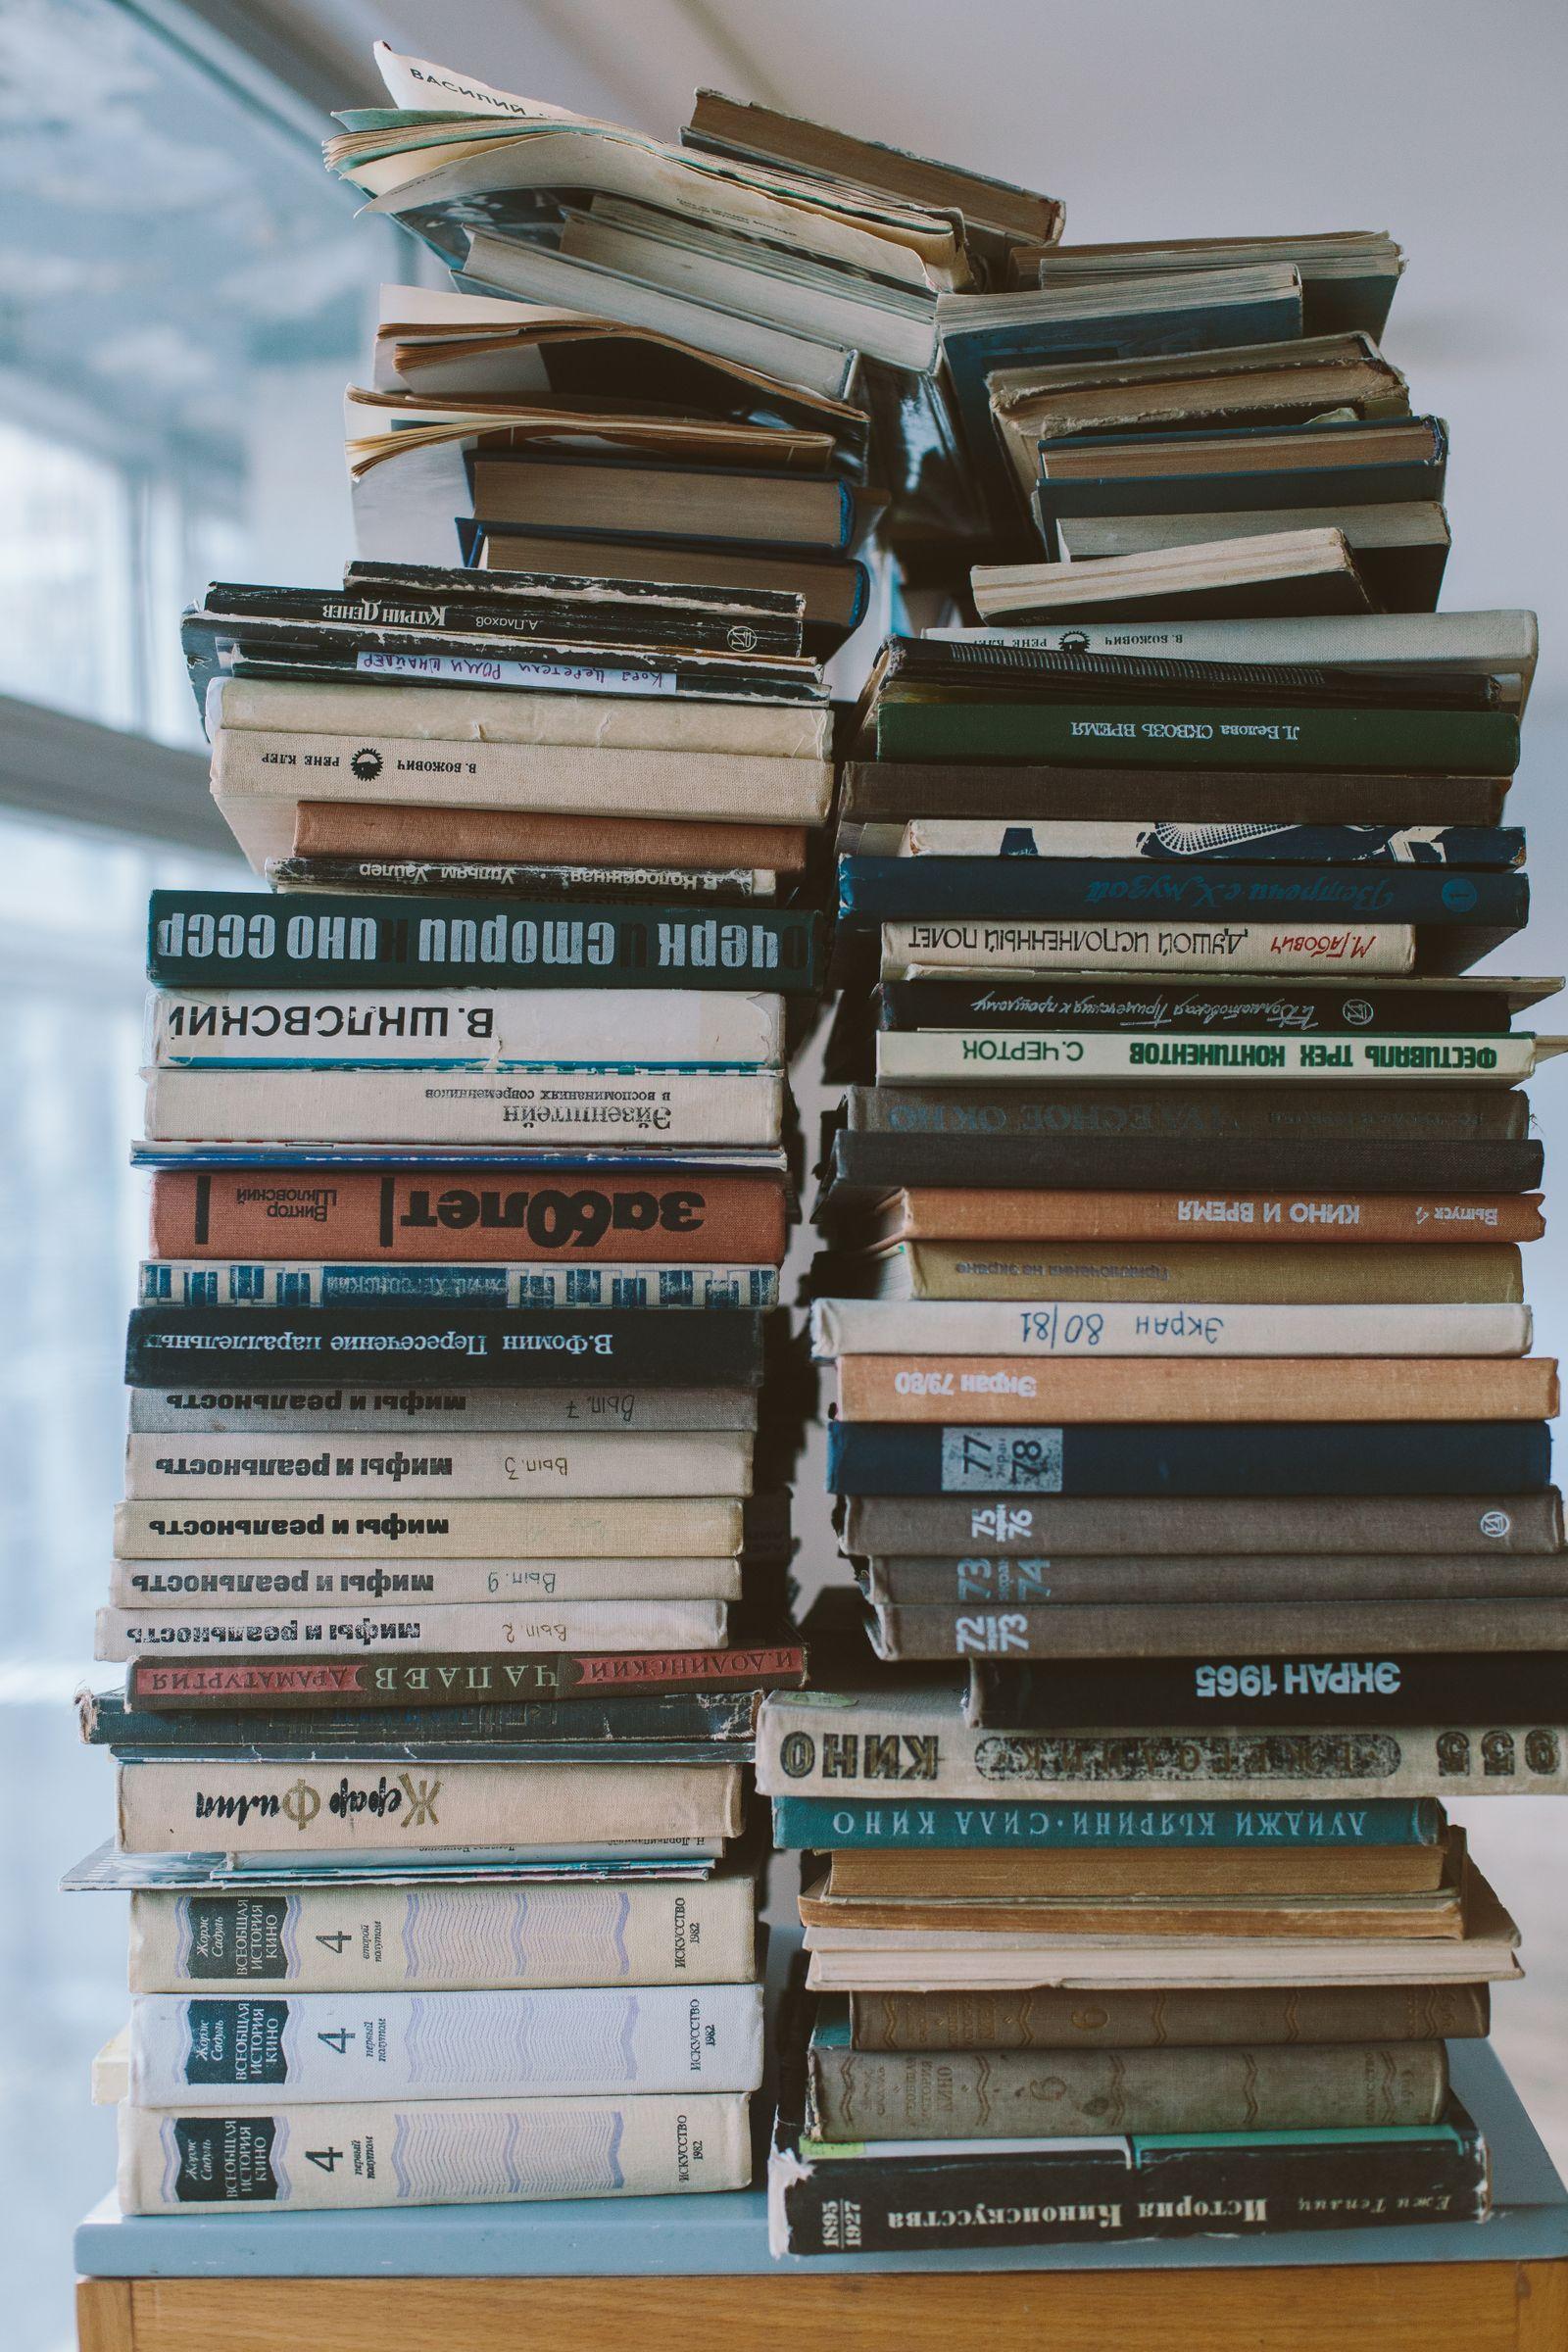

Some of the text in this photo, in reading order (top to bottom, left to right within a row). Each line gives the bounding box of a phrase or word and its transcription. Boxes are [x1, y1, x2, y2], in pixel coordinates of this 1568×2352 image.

[409, 68, 526, 116] ВАСИЛИЙ
[320, 598, 381, 626] ДЕНЕВ
[381, 605, 446, 628] КАТРИН
[1011, 633, 1184, 649] В. БОЖОВИЧ РЕНЕ
[517, 662, 605, 685] Церетели
[621, 669, 662, 689] Кора
[1070, 720, 1299, 741] Л. Белова СКВОЗЬ ВРЕМЯ
[260, 752, 476, 774] В. БОЖОВИЧ РЕНЕ КЛЕР
[1085, 874, 1189, 910] музой
[1245, 875, 1396, 911] Встречи
[458, 1005, 494, 1039] В.
[1129, 1042, 1287, 1068] КОНТИНЕНТОВ
[1298, 1044, 1353, 1068] ТРЕХ
[1363, 1044, 1498, 1070] ФЕСТИВАЛЬ
[424, 1086, 535, 1102] современников
[539, 1087, 659, 1102] воспоминаниях
[502, 1103, 672, 1131] Эйзенштейн
[235, 1186, 337, 1208] Шкловский
[266, 1201, 327, 1222] Виктор
[1178, 1200, 1500, 1225] Выпуск 4 КИНО И ВРЕМЯ
[1018, 1302, 1105, 1349] 80/81
[330, 1329, 487, 1356] Пересечение
[895, 1370, 956, 1396] 79/80
[165, 1388, 466, 1418] мифы и реальность
[564, 1399, 578, 1420] 7
[154, 1451, 453, 1483] мифы и реальность
[504, 1456, 518, 1481] 3
[962, 1434, 993, 1475] 77
[147, 1512, 450, 1543] мифы и реальность
[971, 1508, 996, 1539] 75
[130, 1568, 435, 1598] мифы и реальность
[487, 1570, 500, 1593] 9
[956, 1557, 993, 1600] 73
[125, 1617, 420, 1646] мифы и реальность
[501, 1623, 515, 1644] 2
[955, 1614, 987, 1653] 72
[149, 1665, 349, 1692] ДРАМАТУРГИЯ
[372, 1661, 560, 1690] ЧАПАЕВ
[1196, 1660, 1401, 1697] ЭКРАН 1965
[779, 1731, 940, 1782] КИНО
[194, 1769, 442, 1832] Жерар Филип
[831, 1809, 1367, 1838] ЛУИДЖИ КЬЯРИНИ СИЛА КИНО
[196, 1916, 210, 1958] Жорж
[211, 1916, 224, 1958] Садуль
[235, 1898, 249, 1976] ВСЕОБЩАЯ
[250, 1903, 264, 1970] ИСТОРИЯ
[266, 1914, 278, 1959] КИНО
[316, 1930, 353, 1954] 4
[674, 1896, 686, 1969] ИСКУССТВО
[689, 1922, 701, 1944] 1982
[195, 2019, 210, 2060] Жорж
[211, 2019, 224, 2061] Садуль
[235, 2001, 250, 2081] ВСЕОБЩАЯ
[251, 2007, 265, 2075] ИСТОРИЯ
[266, 2017, 279, 2063] КИНО
[316, 2027, 356, 2054] 4
[690, 1998, 701, 2072] ИСКУССТВО
[705, 2024, 716, 2048] 1982
[185, 2138, 199, 2181] Жорж
[200, 2138, 214, 2181] Садуль
[224, 2120, 239, 2198] ВСЕОБЩАЯ
[239, 2126, 253, 2193] ИСТОРИЯ
[254, 2135, 268, 2181] КИНО
[305, 2146, 344, 2173] 4
[677, 2115, 688, 2183] ИСКУССТВО
[693, 2140, 704, 2162] 1982
[823, 2201, 839, 2247] 1895
[843, 2198, 862, 2246] 1927
[887, 2193, 1454, 2230] Ежи Теплиц История Киноискусства
